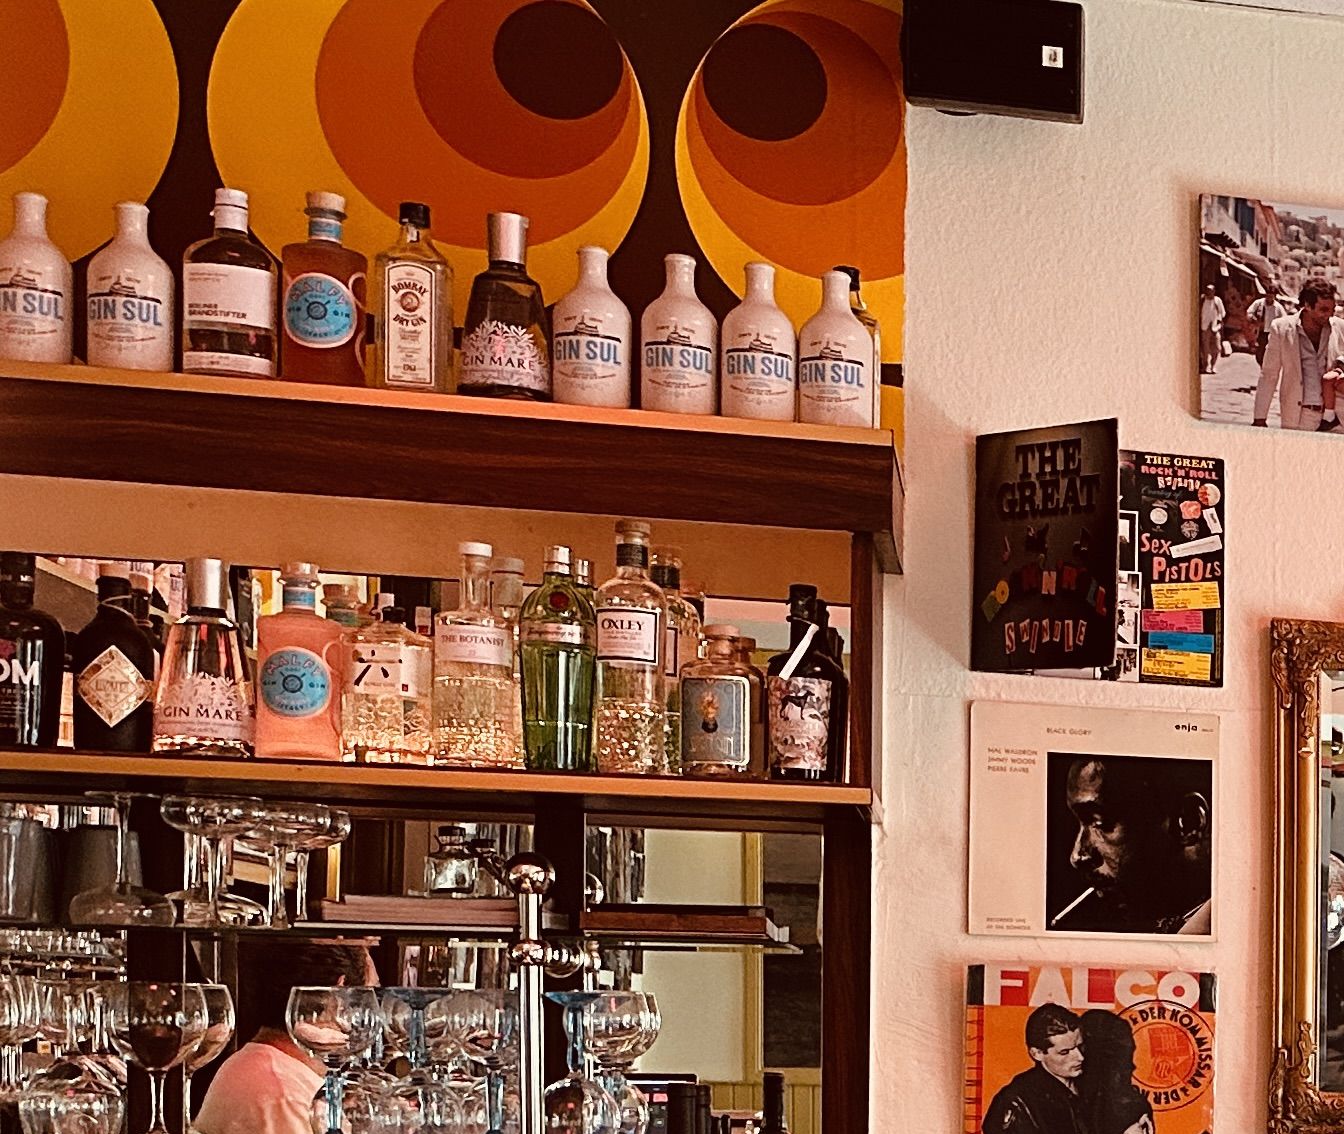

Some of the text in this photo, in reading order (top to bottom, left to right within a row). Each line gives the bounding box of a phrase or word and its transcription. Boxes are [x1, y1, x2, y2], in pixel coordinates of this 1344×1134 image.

[391, 281, 430, 297] BOMBAY
[23, 293, 64, 320] SUL
[89, 298, 162, 326] GIN SUL
[463, 355, 536, 371] GIN MARE
[555, 338, 622, 365] GIN SUL
[645, 346, 712, 374] GIN SUL
[726, 354, 793, 382] GIN SUL
[801, 362, 865, 388] GIN SUL
[1015, 438, 1081, 480] THE
[1144, 455, 1216, 469] THE GREAT
[1141, 465, 1173, 476] ROCK
[1189, 469, 1219, 480] ROLL
[998, 474, 1100, 517] GREAT
[1140, 532, 1172, 555] Sex
[601, 618, 644, 631] OXLEY
[1004, 617, 1088, 655] SWINDLE
[441, 634, 505, 648] THE BOTANIST
[267, 655, 323, 676] MALFY
[163, 706, 244, 722] GIN MARE
[1046, 727, 1066, 735] BLACK
[1174, 722, 1198, 733] enja
[984, 964, 1201, 1011] FALCO
[1138, 1006, 1213, 1089] DER KOMMISSAR
